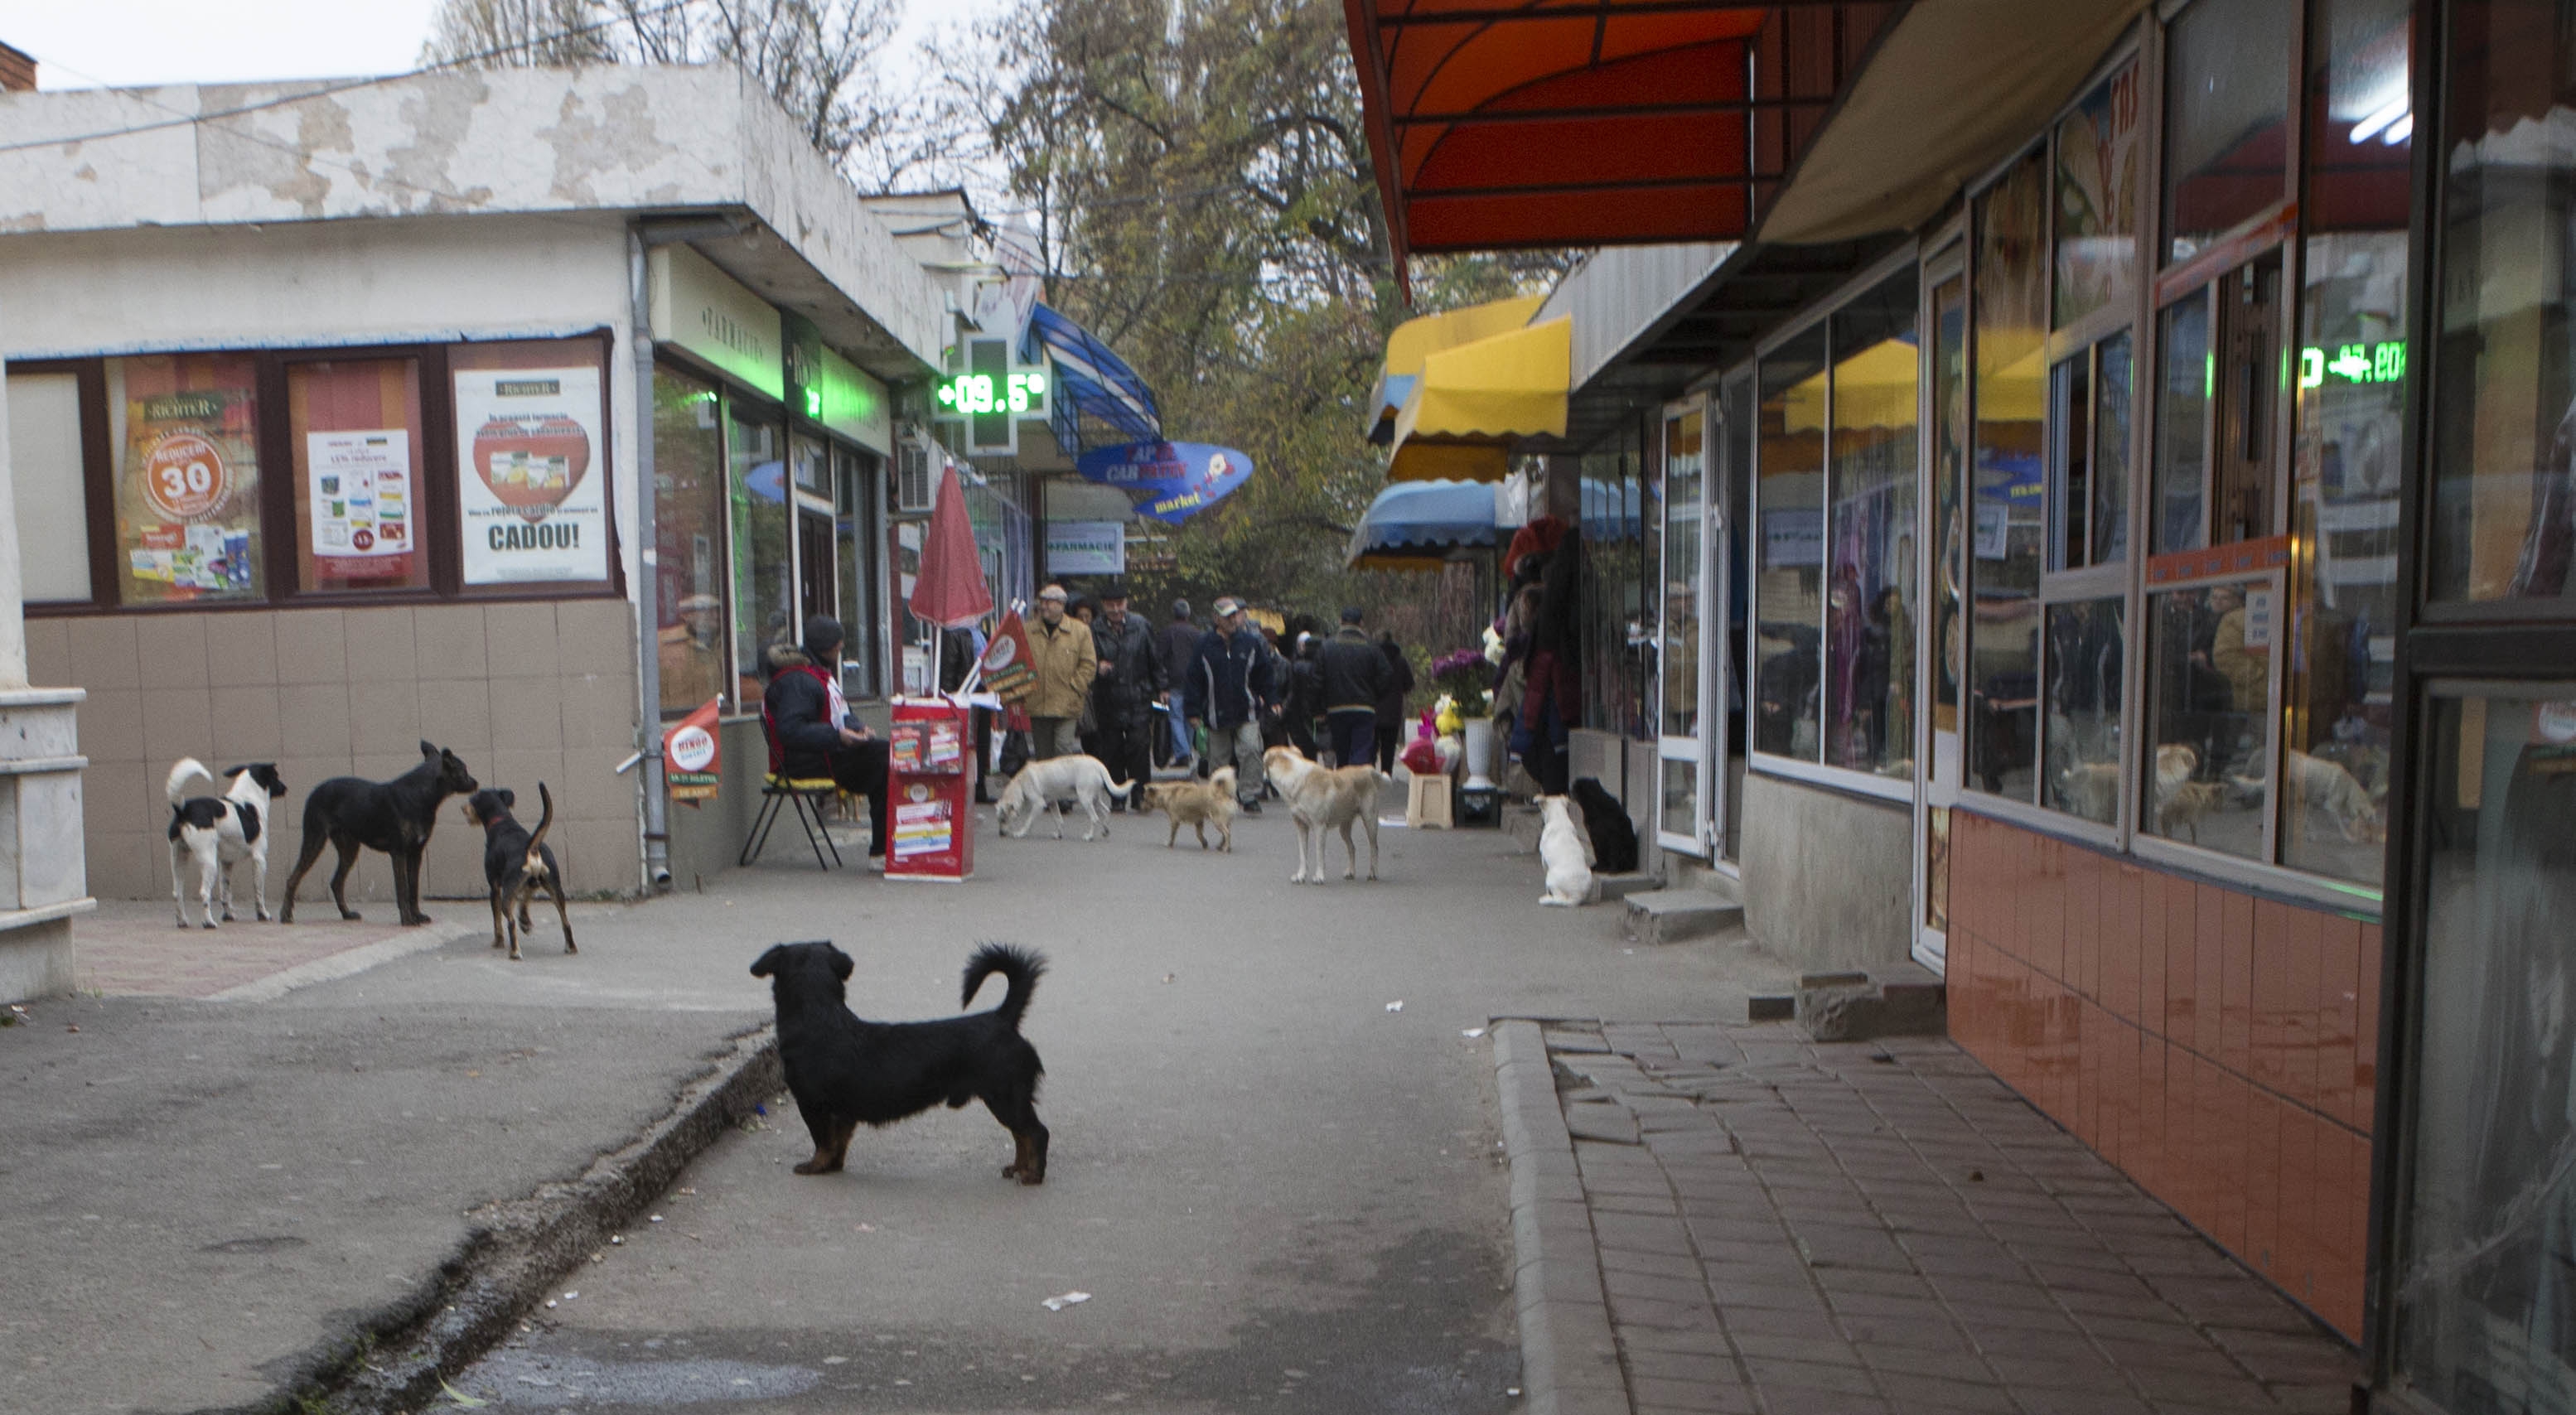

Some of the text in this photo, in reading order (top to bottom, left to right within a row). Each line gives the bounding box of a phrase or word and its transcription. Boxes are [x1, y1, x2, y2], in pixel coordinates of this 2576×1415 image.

[162, 461, 211, 498] 30
[1155, 493, 1200, 513] market
[488, 523, 580, 551] CADOU!
